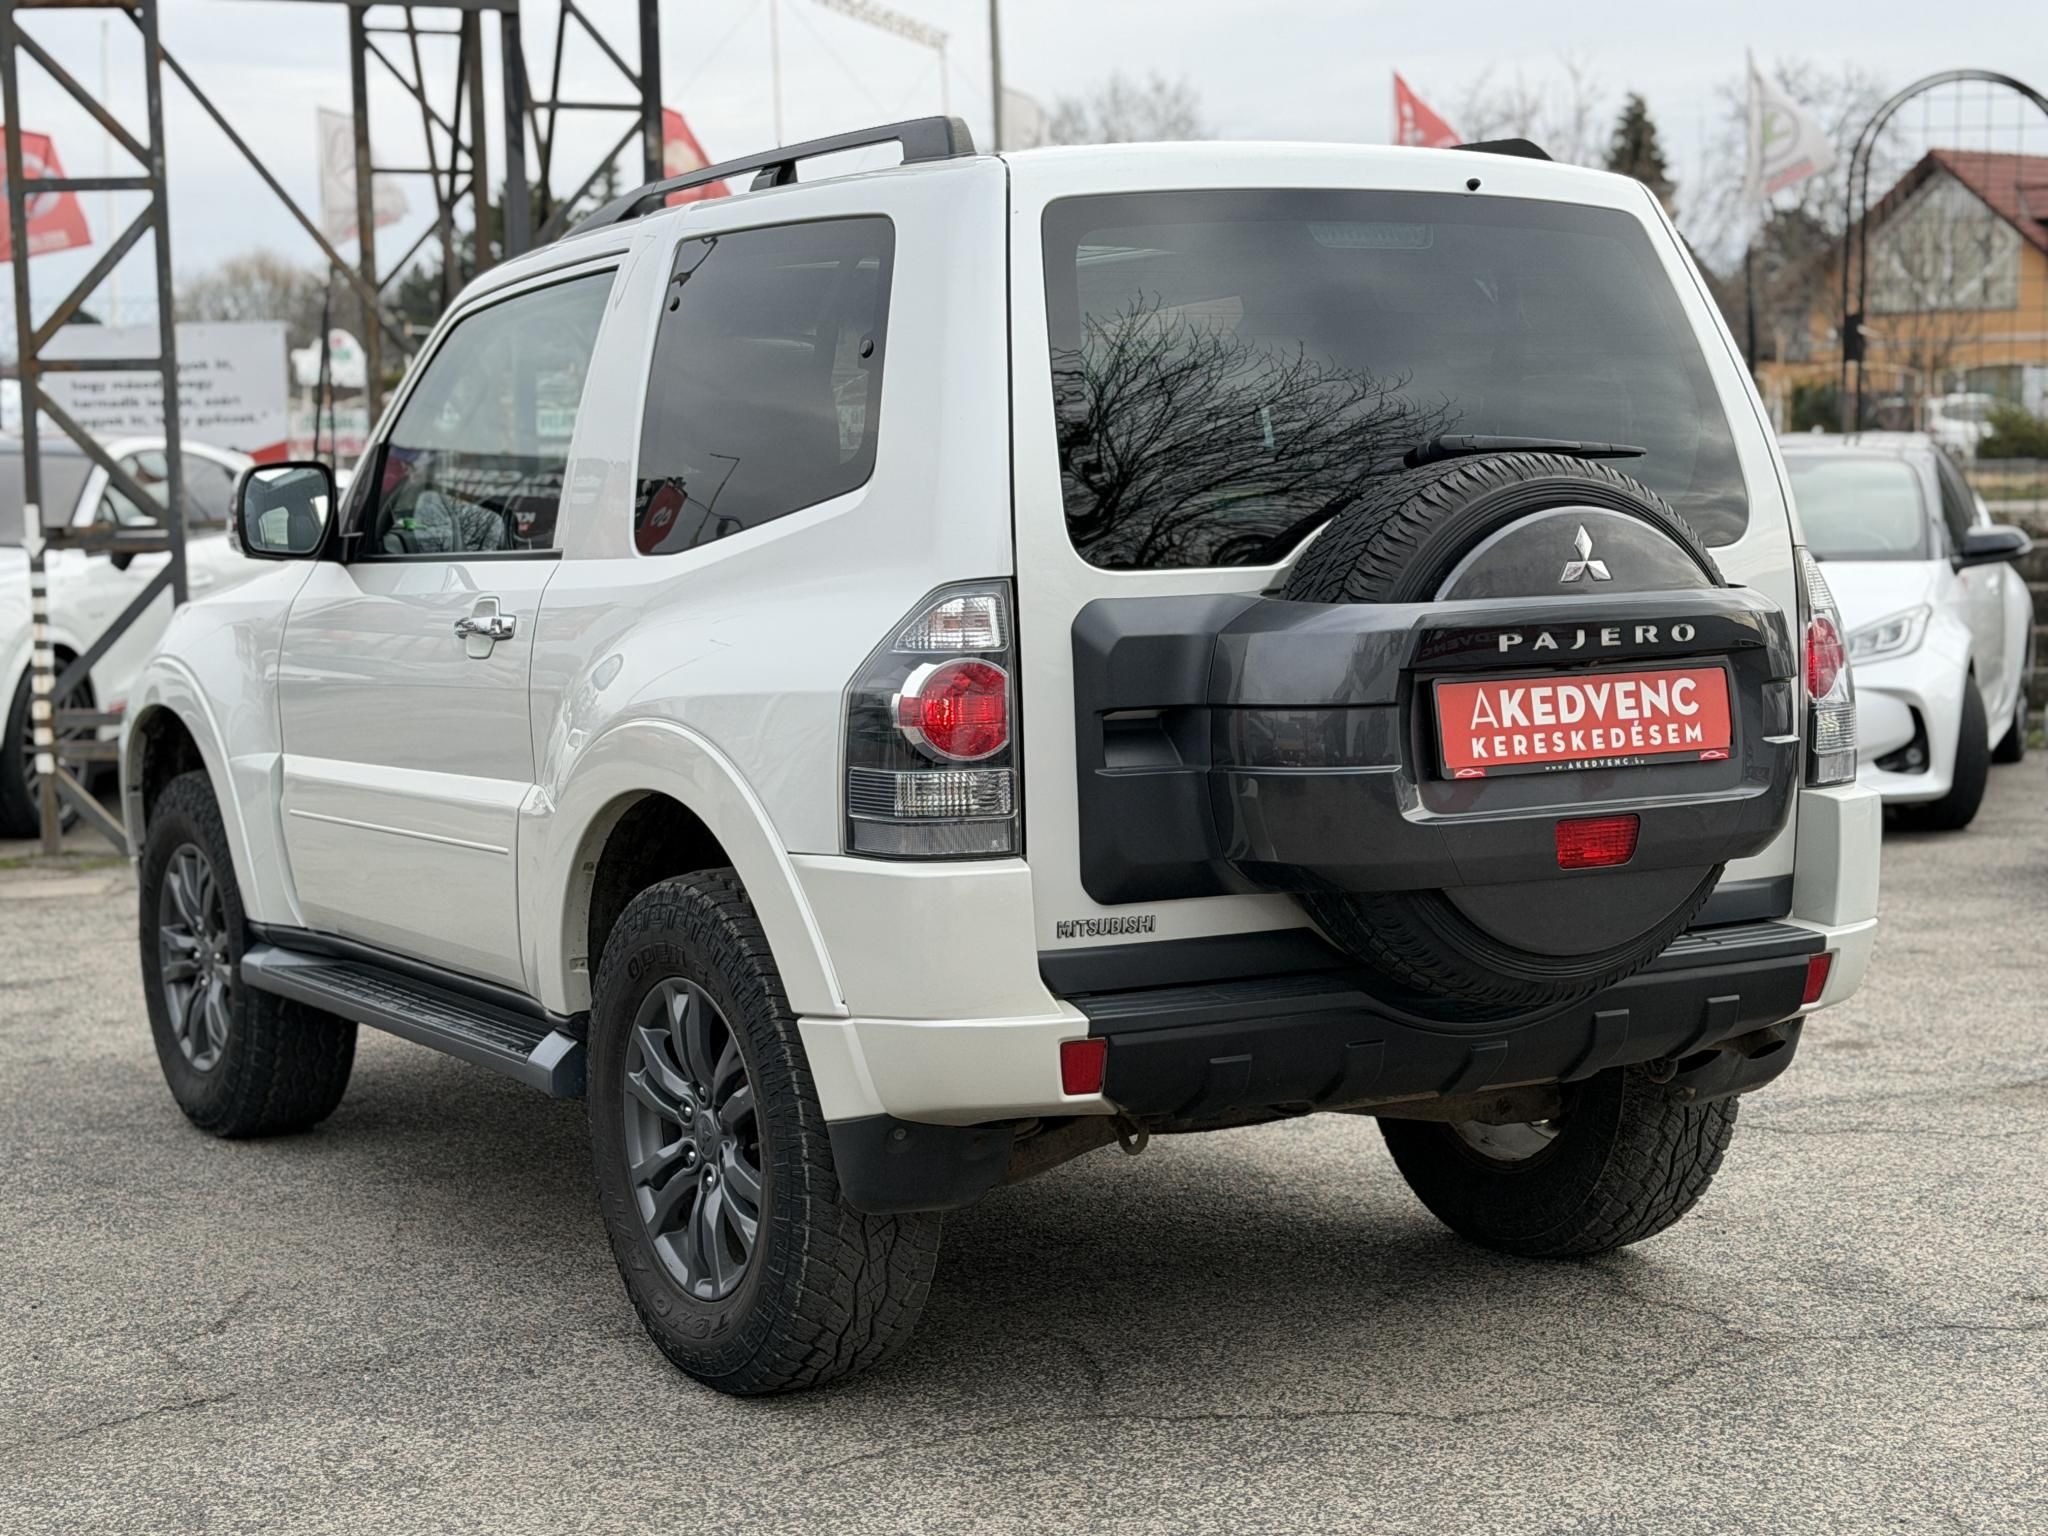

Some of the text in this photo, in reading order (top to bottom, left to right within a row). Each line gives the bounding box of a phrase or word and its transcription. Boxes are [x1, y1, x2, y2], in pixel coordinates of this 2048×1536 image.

[1500, 623, 1696, 652] PAJERO
[1472, 720, 1703, 758] KERESKEDÉSEM
[1056, 915, 1156, 939] MITSUBISHI
